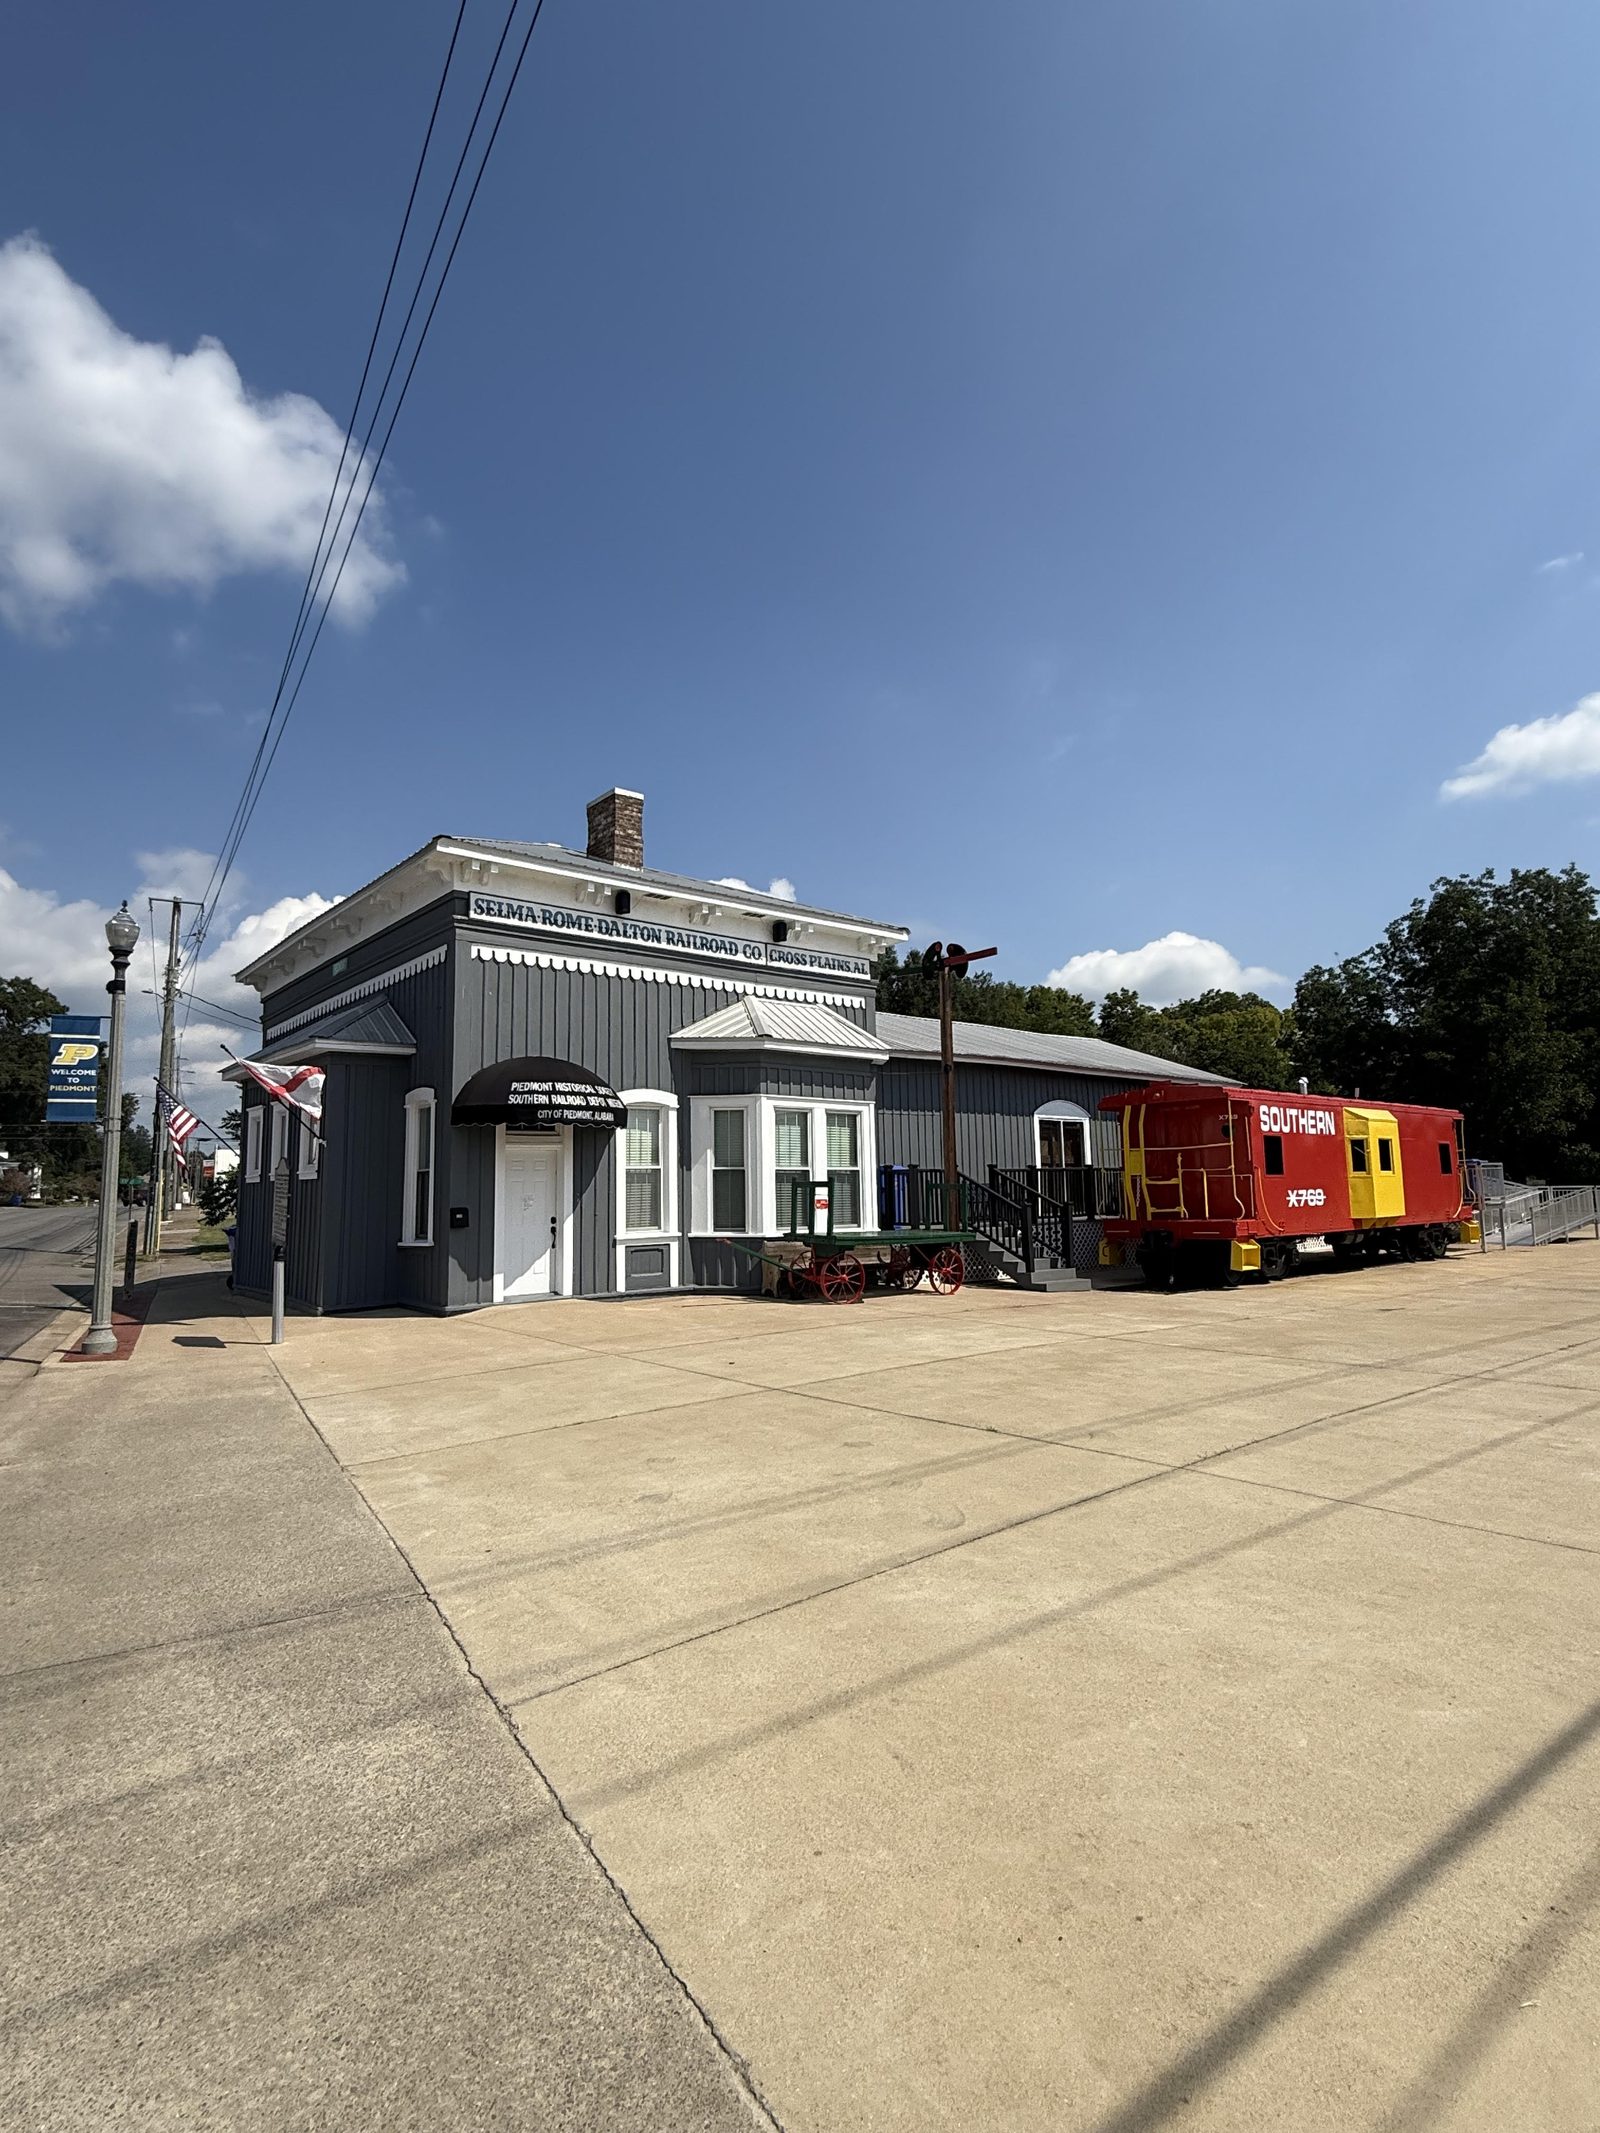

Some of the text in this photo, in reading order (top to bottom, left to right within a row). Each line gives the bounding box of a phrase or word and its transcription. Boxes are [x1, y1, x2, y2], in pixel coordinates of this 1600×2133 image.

[665, 930, 739, 956] RAILROAD
[769, 949, 807, 967] CROSS
[510, 1082, 553, 1092] PIEDMONT
[554, 1081, 596, 1094] HISTORICAL
[508, 1093, 549, 1105] SOUTHERN
[551, 1094, 587, 1106] RAILROAD
[537, 1109, 553, 1119] CITY
[553, 1109, 562, 1118] OF
[1260, 1104, 1335, 1135] SOUTHERN
[1287, 1188, 1325, 1208] X769
